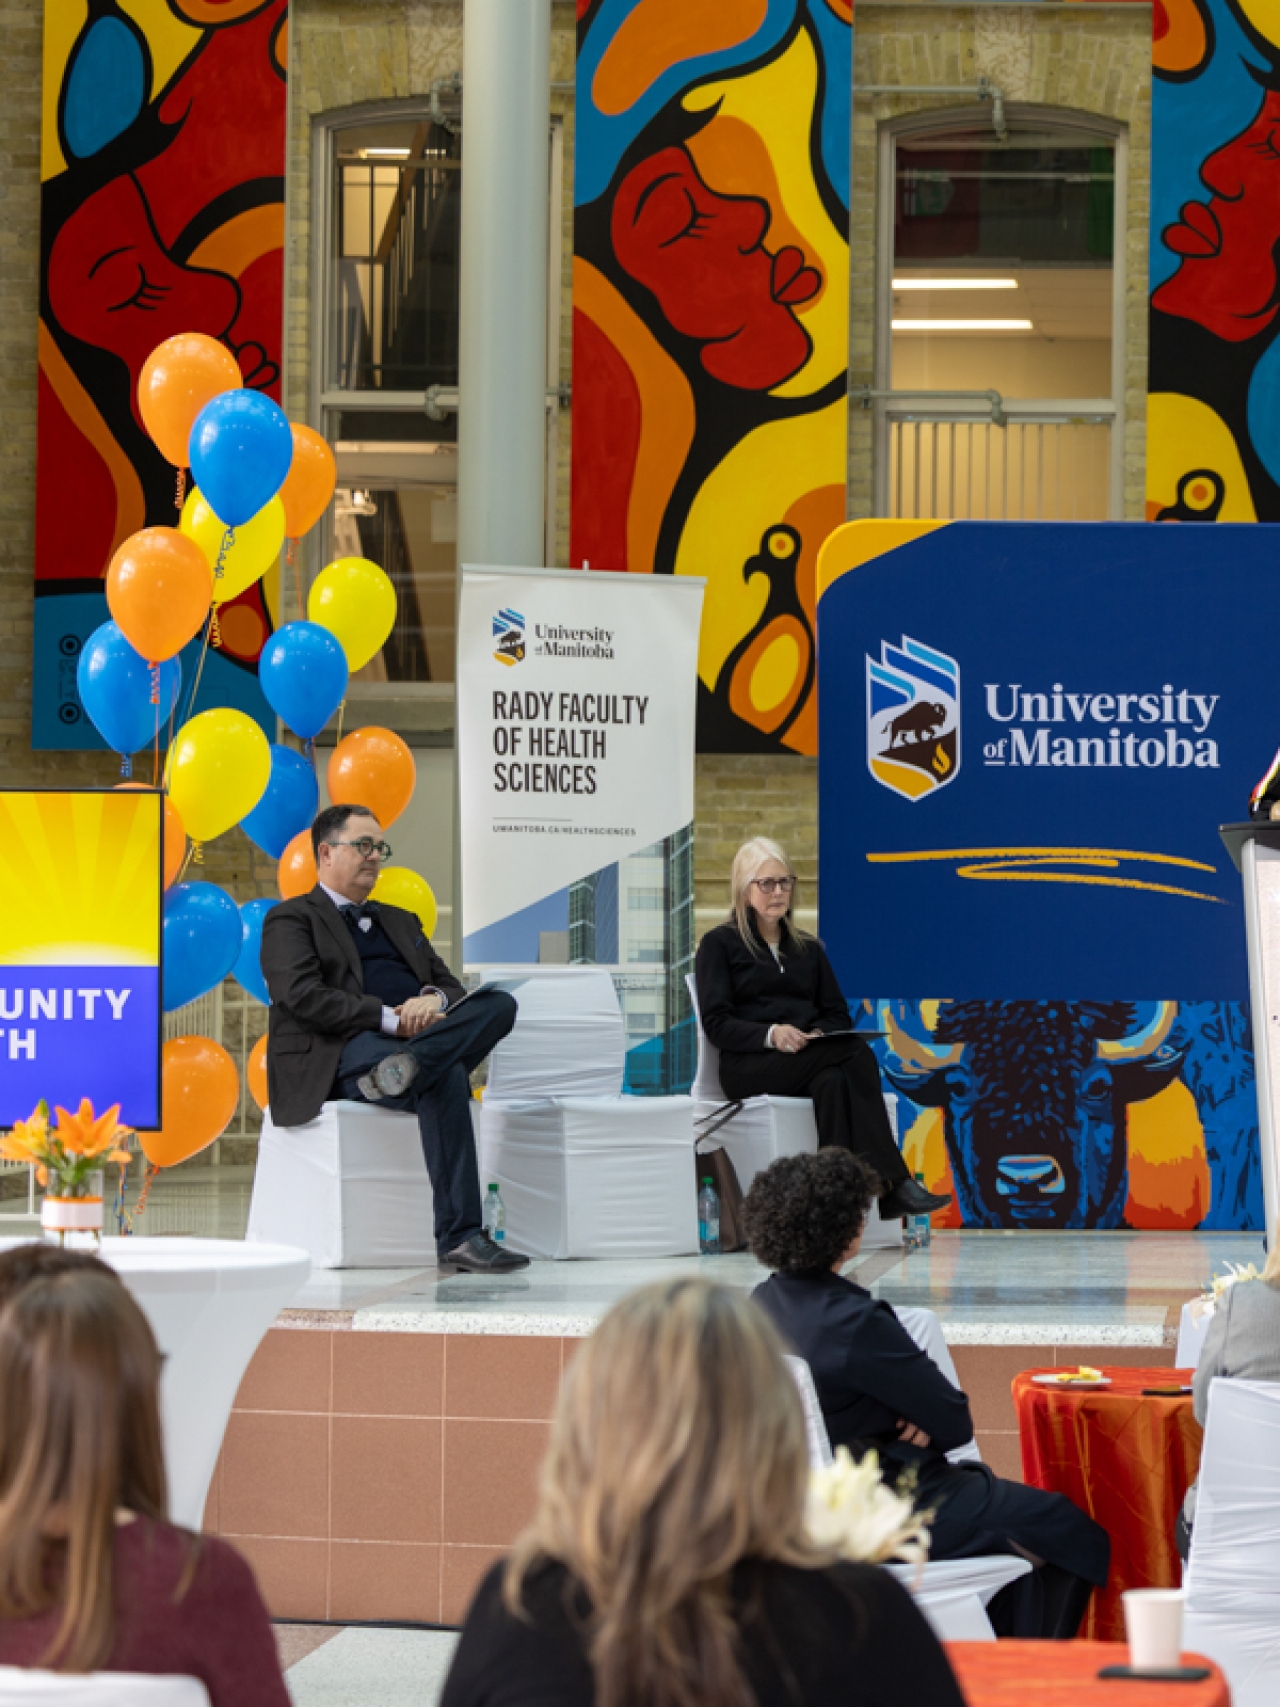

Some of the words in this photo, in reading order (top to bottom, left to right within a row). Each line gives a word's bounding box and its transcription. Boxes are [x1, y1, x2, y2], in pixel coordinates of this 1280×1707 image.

[534, 623, 615, 644] University
[543, 641, 615, 660] Manitoba
[492, 690, 553, 721] RADY
[558, 692, 649, 725] FACULTY
[982, 682, 1221, 733] University
[493, 726, 523, 756] OF
[528, 727, 607, 759] HEALTH
[982, 737, 1008, 766] of
[1008, 727, 1221, 769] Manitoba
[493, 761, 597, 795] SCIENCES
